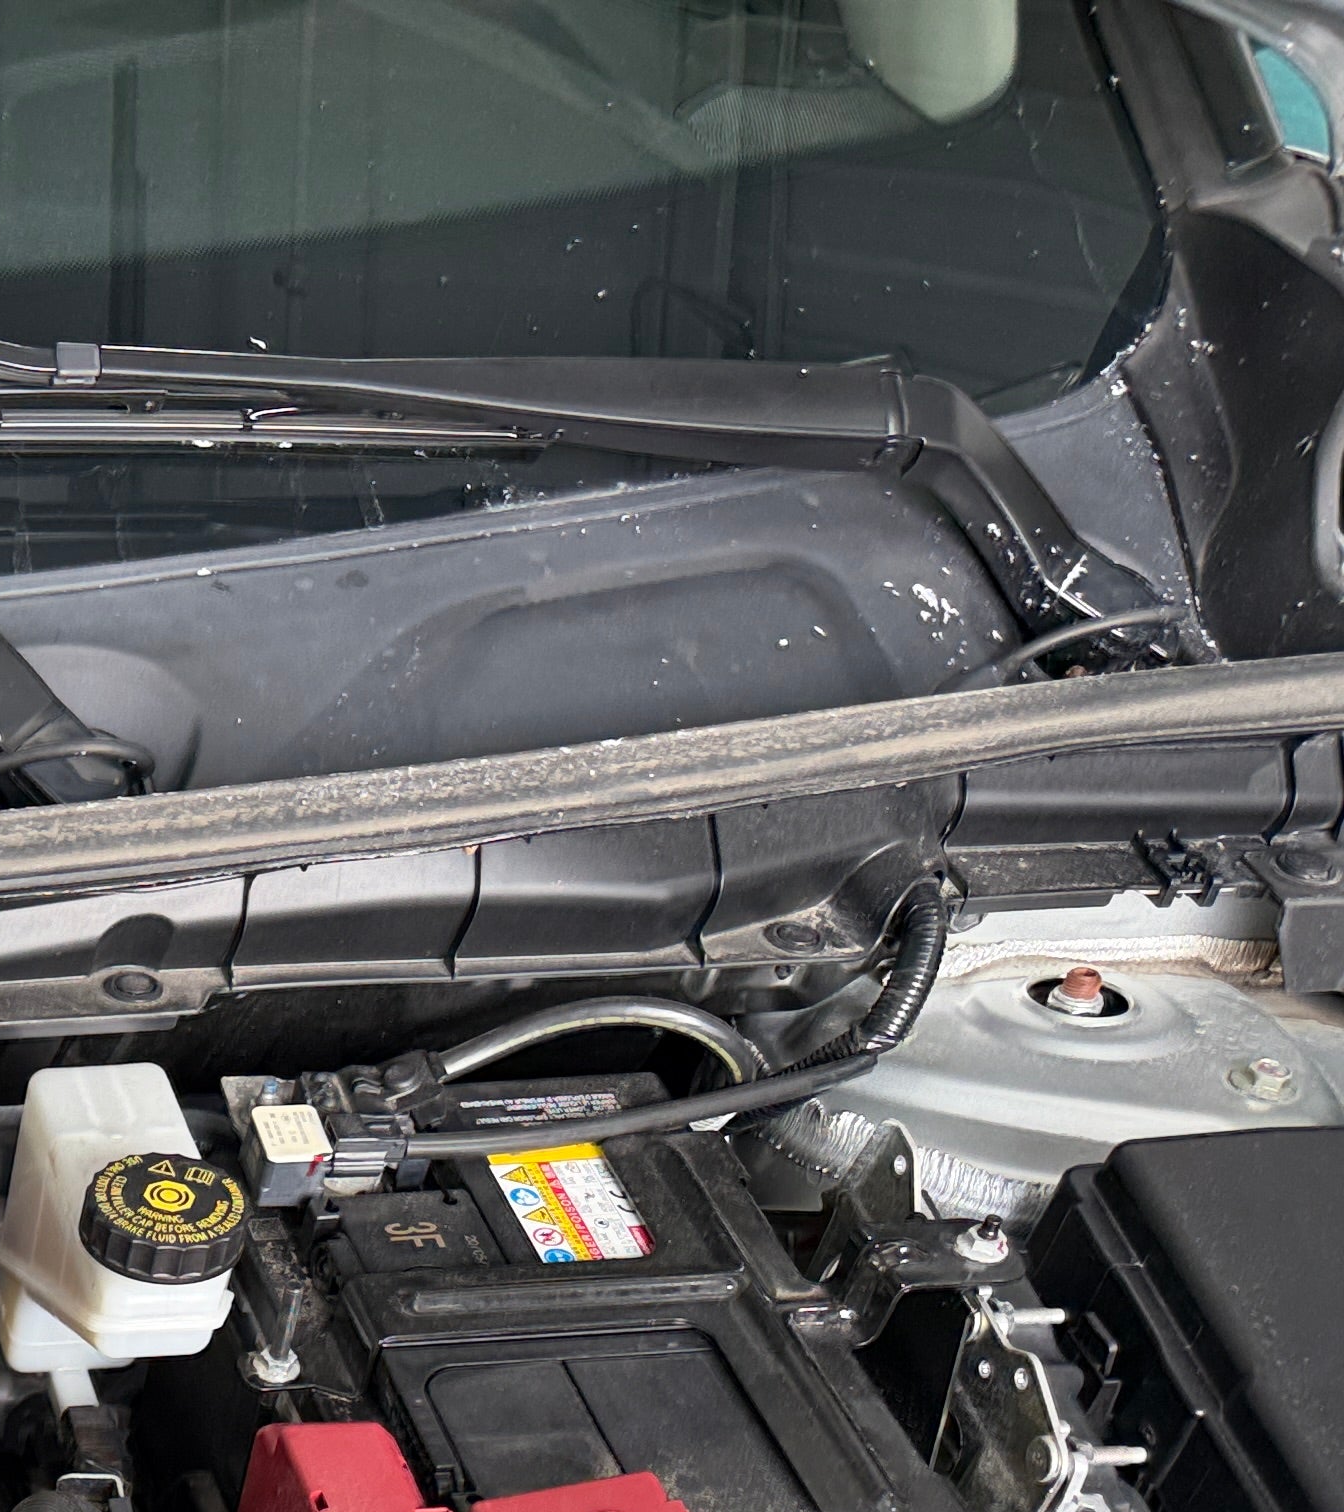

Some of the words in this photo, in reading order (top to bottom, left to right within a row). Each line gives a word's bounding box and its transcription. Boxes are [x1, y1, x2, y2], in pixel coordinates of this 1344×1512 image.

[132, 1215, 153, 1228] CAP
[154, 1222, 198, 1234] BEFORE
[137, 1205, 185, 1224] WARNING
[113, 1217, 145, 1237] BRAKE
[146, 1230, 177, 1244] FLUID
[178, 1231, 209, 1244] FROM
[207, 1229, 218, 1239] A
[213, 1212, 242, 1235] SEALED
[384, 1220, 447, 1250] 3F
